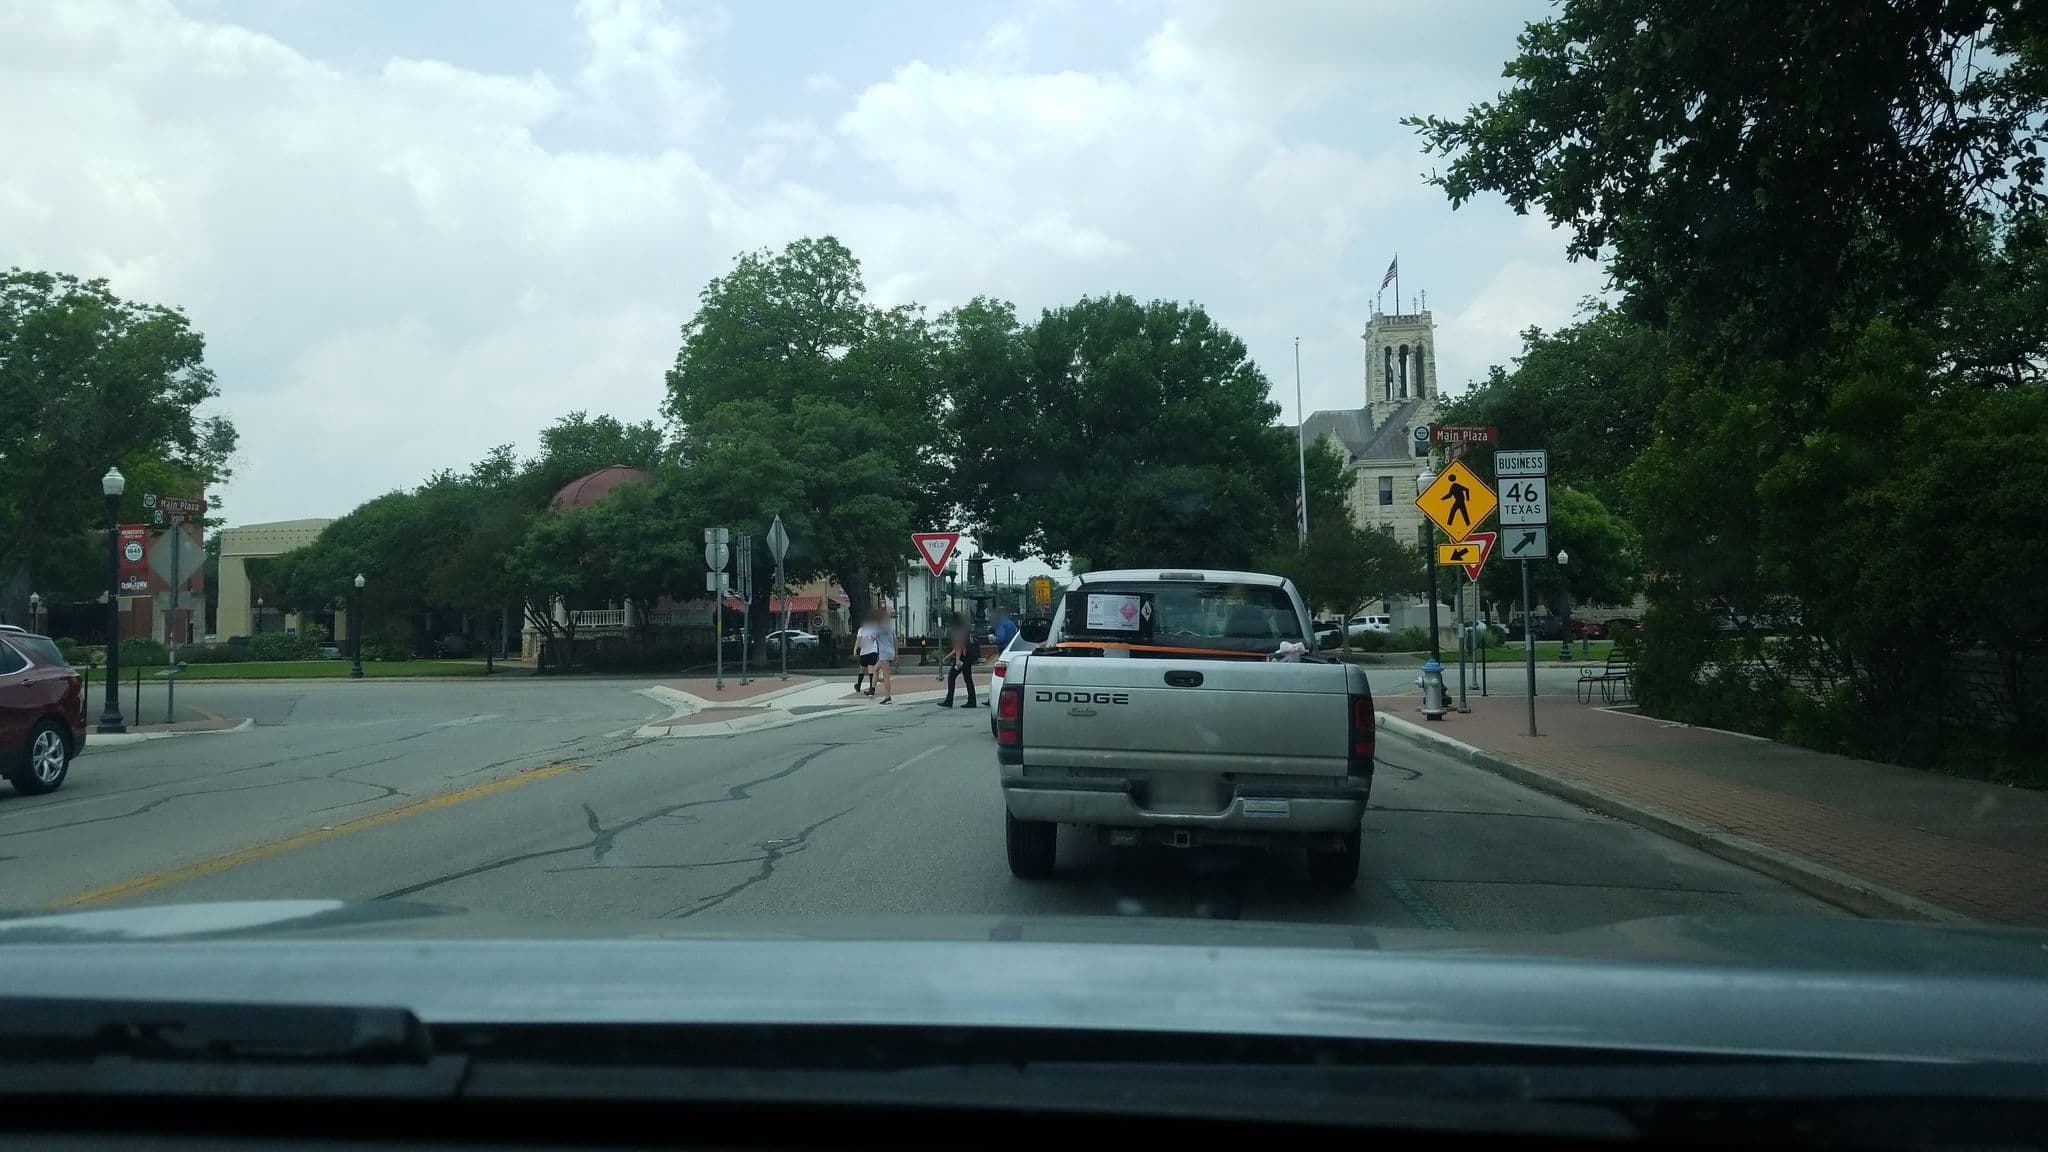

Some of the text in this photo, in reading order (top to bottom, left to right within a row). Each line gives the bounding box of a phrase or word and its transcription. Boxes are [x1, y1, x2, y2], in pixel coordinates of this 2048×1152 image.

[1437, 430, 1459, 441] Main
[1463, 430, 1488, 441] Plaza
[1499, 456, 1543, 470] BUSINESS
[1506, 482, 1538, 503] 46
[160, 499, 177, 510] Main
[180, 501, 200, 512] Plaza
[1504, 504, 1541, 515] TEXAS
[1035, 691, 1129, 705] DODGE
